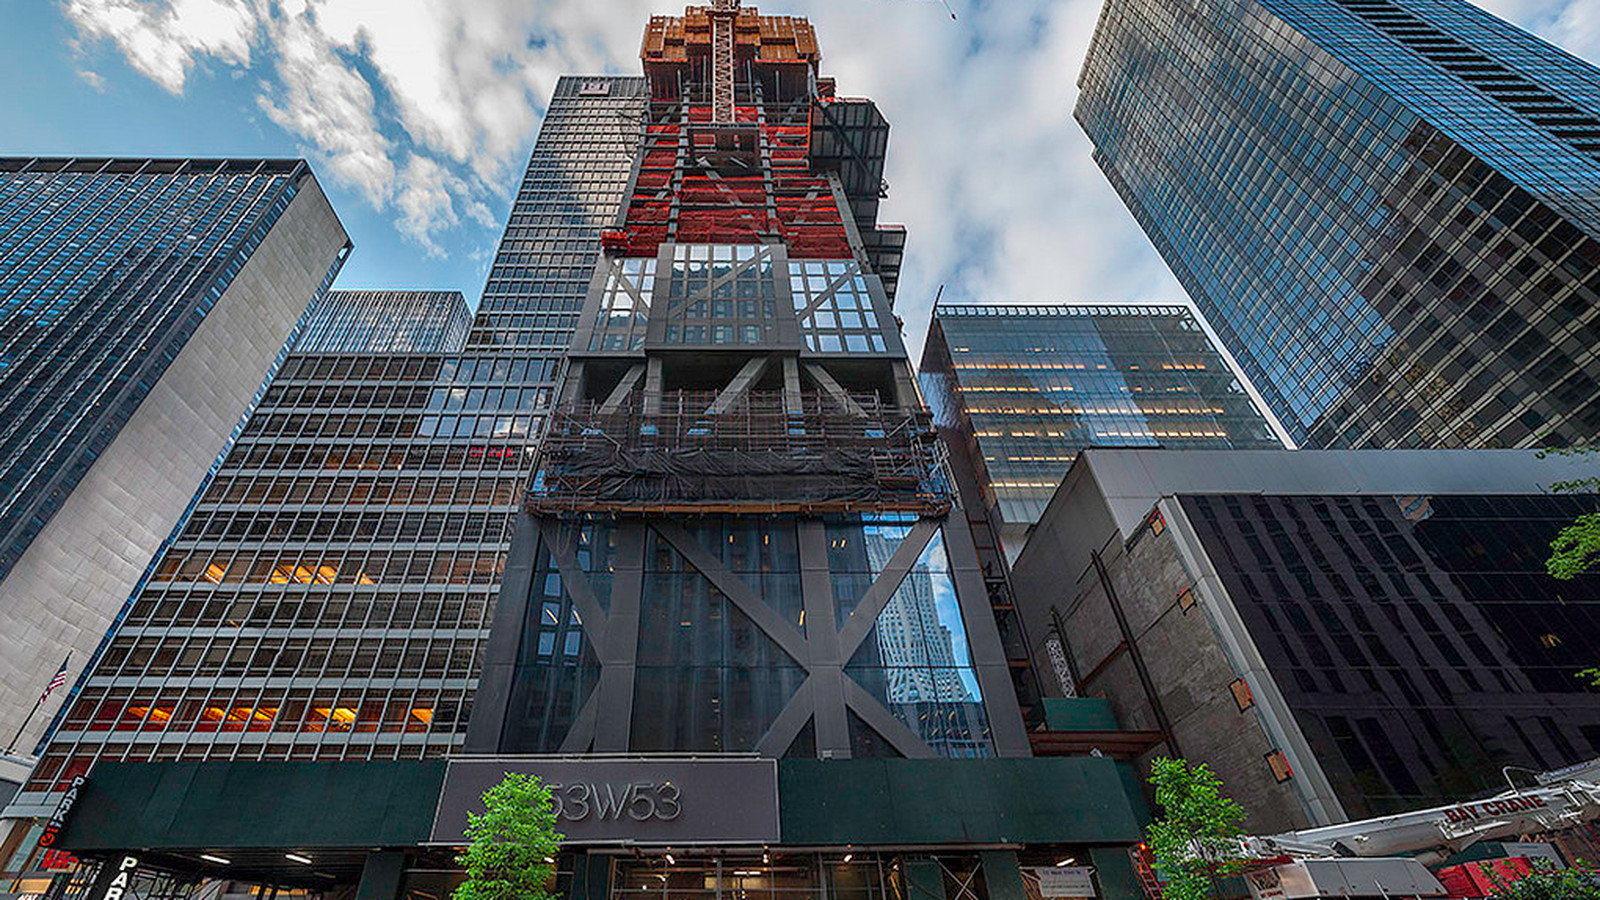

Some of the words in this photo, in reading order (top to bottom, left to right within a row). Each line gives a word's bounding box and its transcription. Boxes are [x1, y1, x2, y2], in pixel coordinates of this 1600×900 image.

[543, 782, 682, 821] 53W53
[1443, 804, 1480, 824] BAY
[1482, 794, 1548, 817] CRANE
